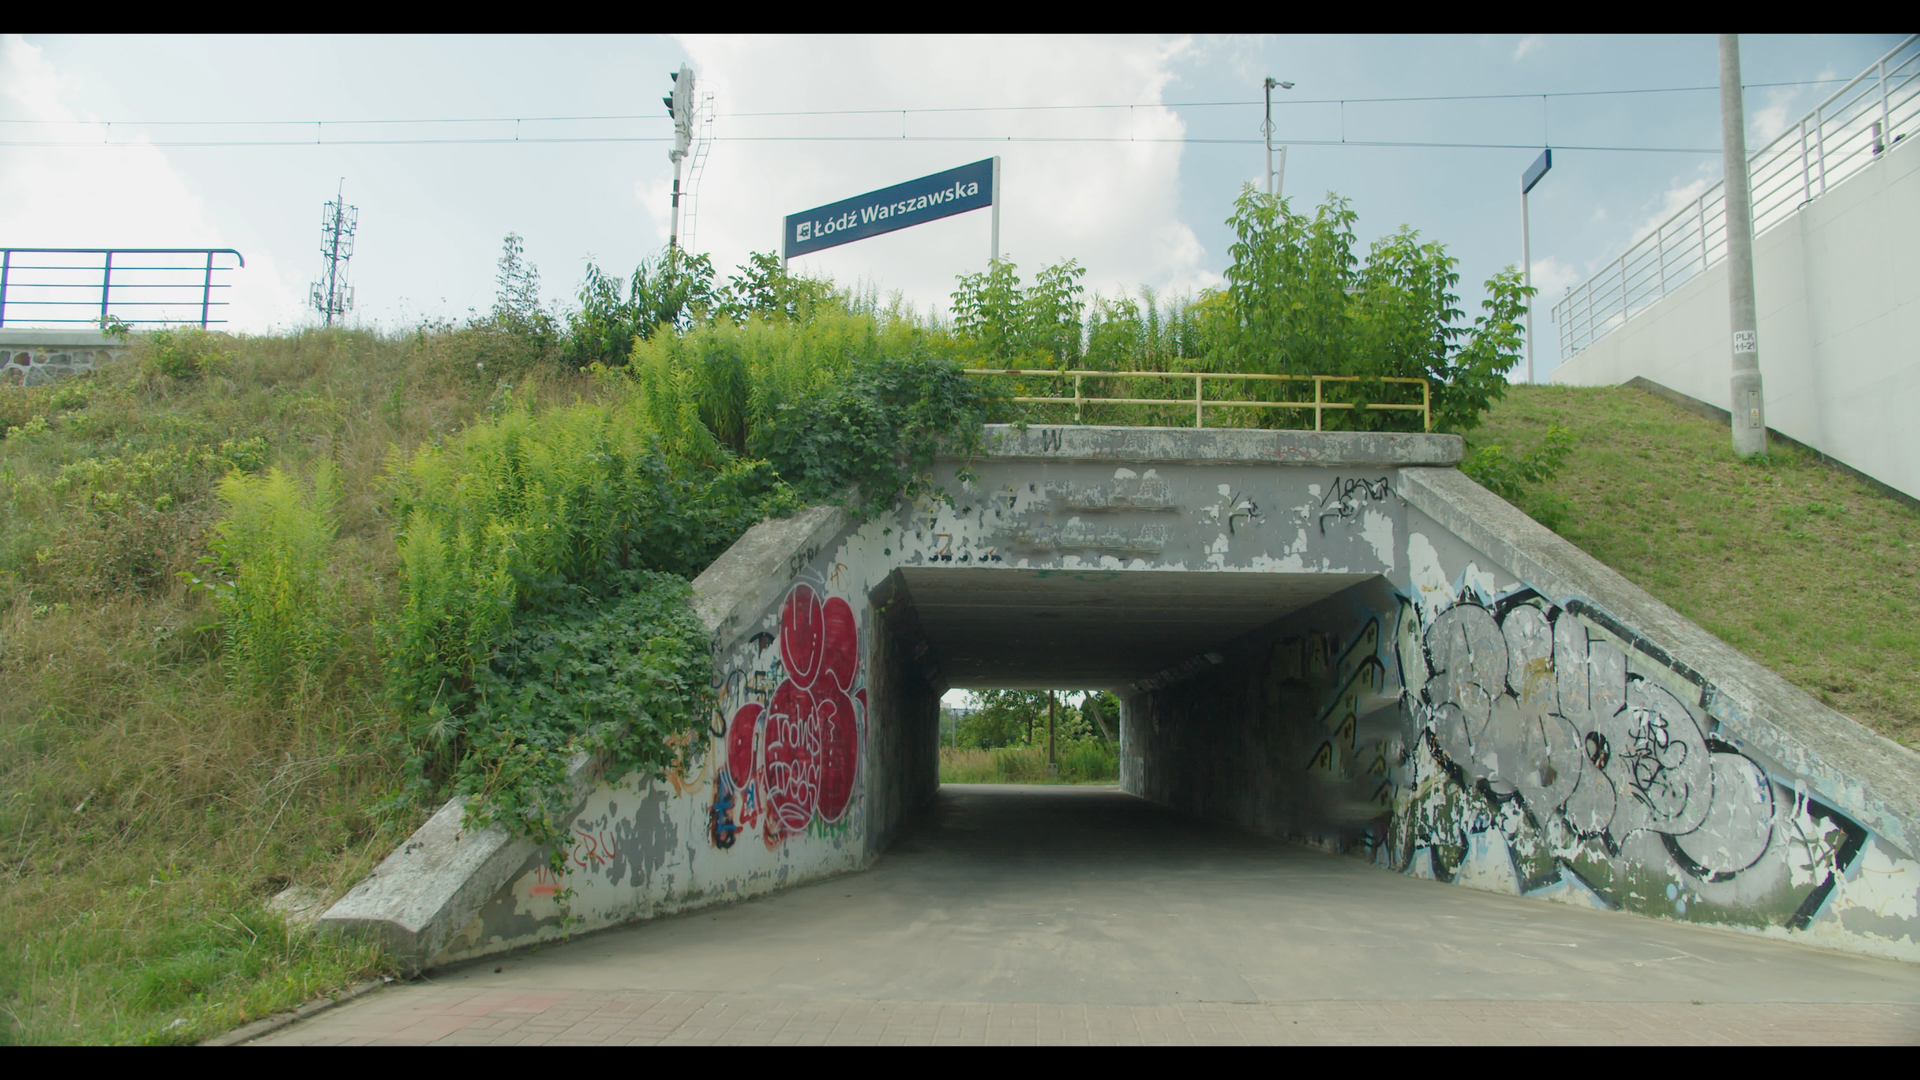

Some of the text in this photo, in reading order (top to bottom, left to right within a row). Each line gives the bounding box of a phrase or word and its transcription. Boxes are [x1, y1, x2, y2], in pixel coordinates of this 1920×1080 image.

[813, 181, 979, 238] Łódź Warszawska
[1736, 332, 1754, 341] PLK
